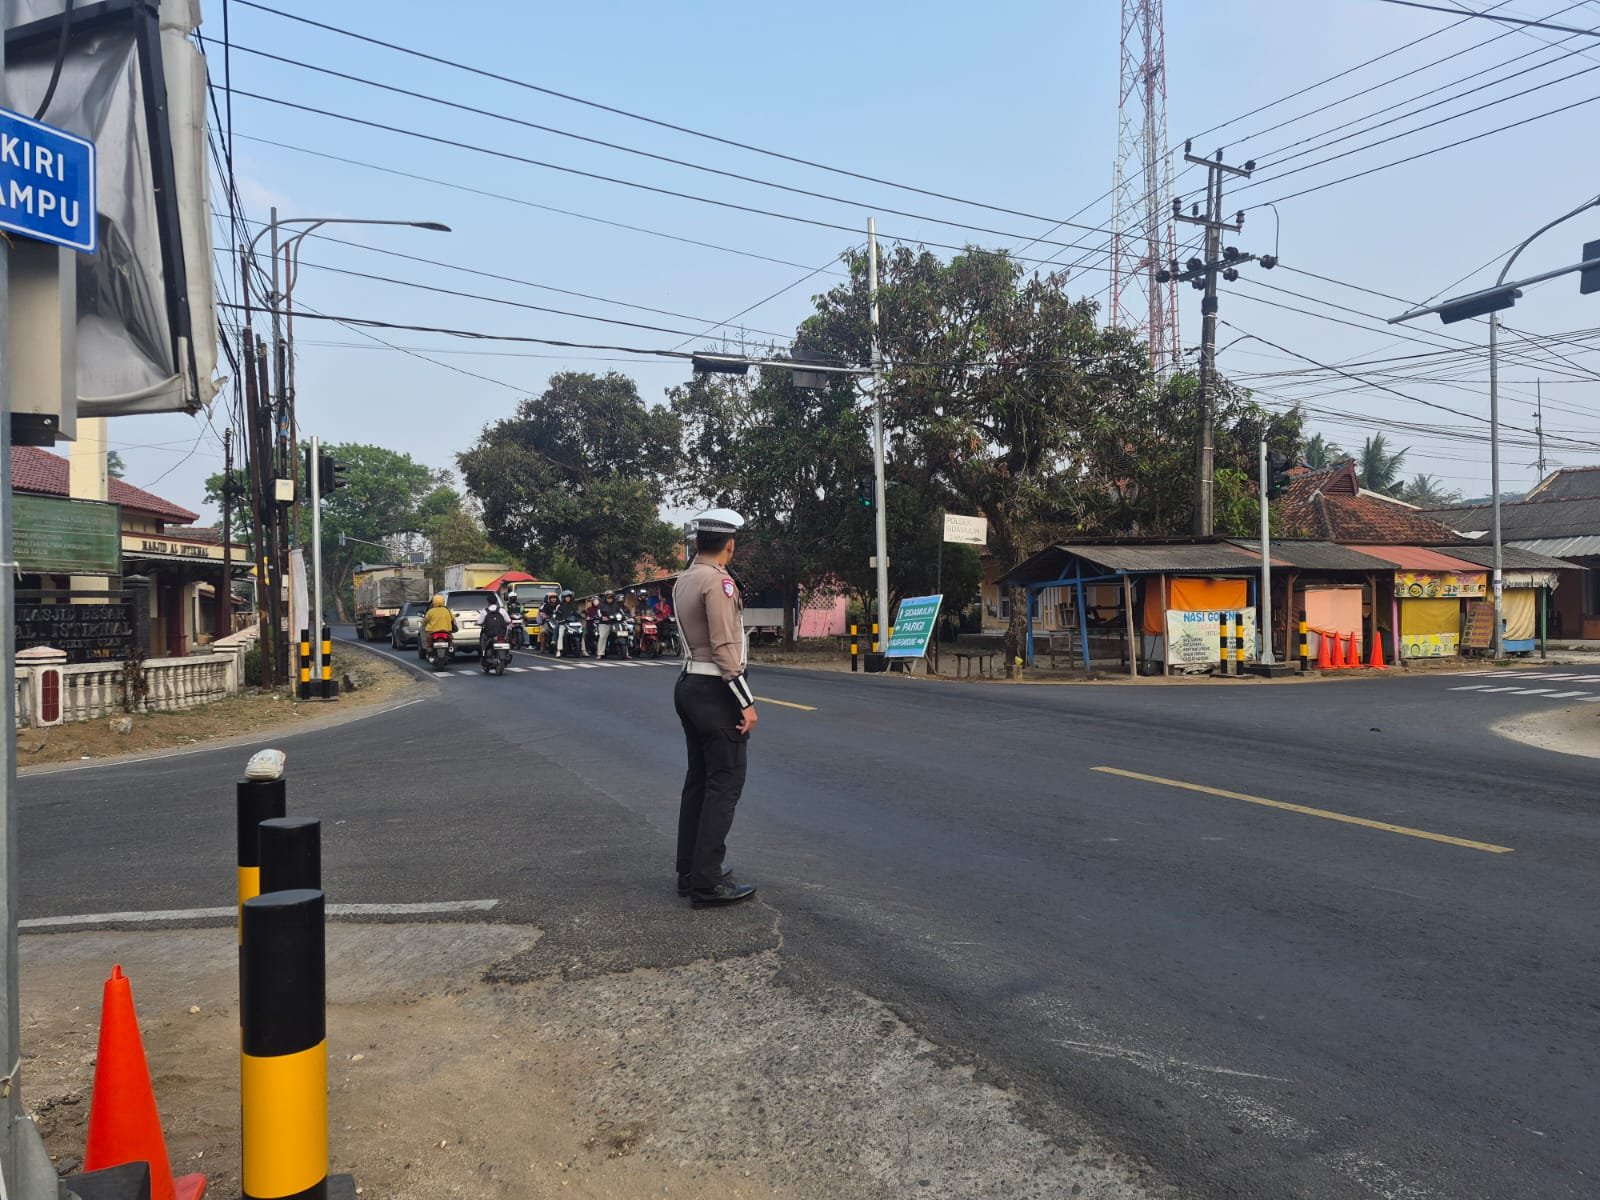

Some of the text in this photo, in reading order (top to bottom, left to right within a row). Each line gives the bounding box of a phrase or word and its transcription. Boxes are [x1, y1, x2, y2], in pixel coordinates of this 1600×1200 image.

[2, 133, 64, 182] KIRI
[1183, 612, 1204, 622] NASI
[902, 621, 925, 632] PARIGI
